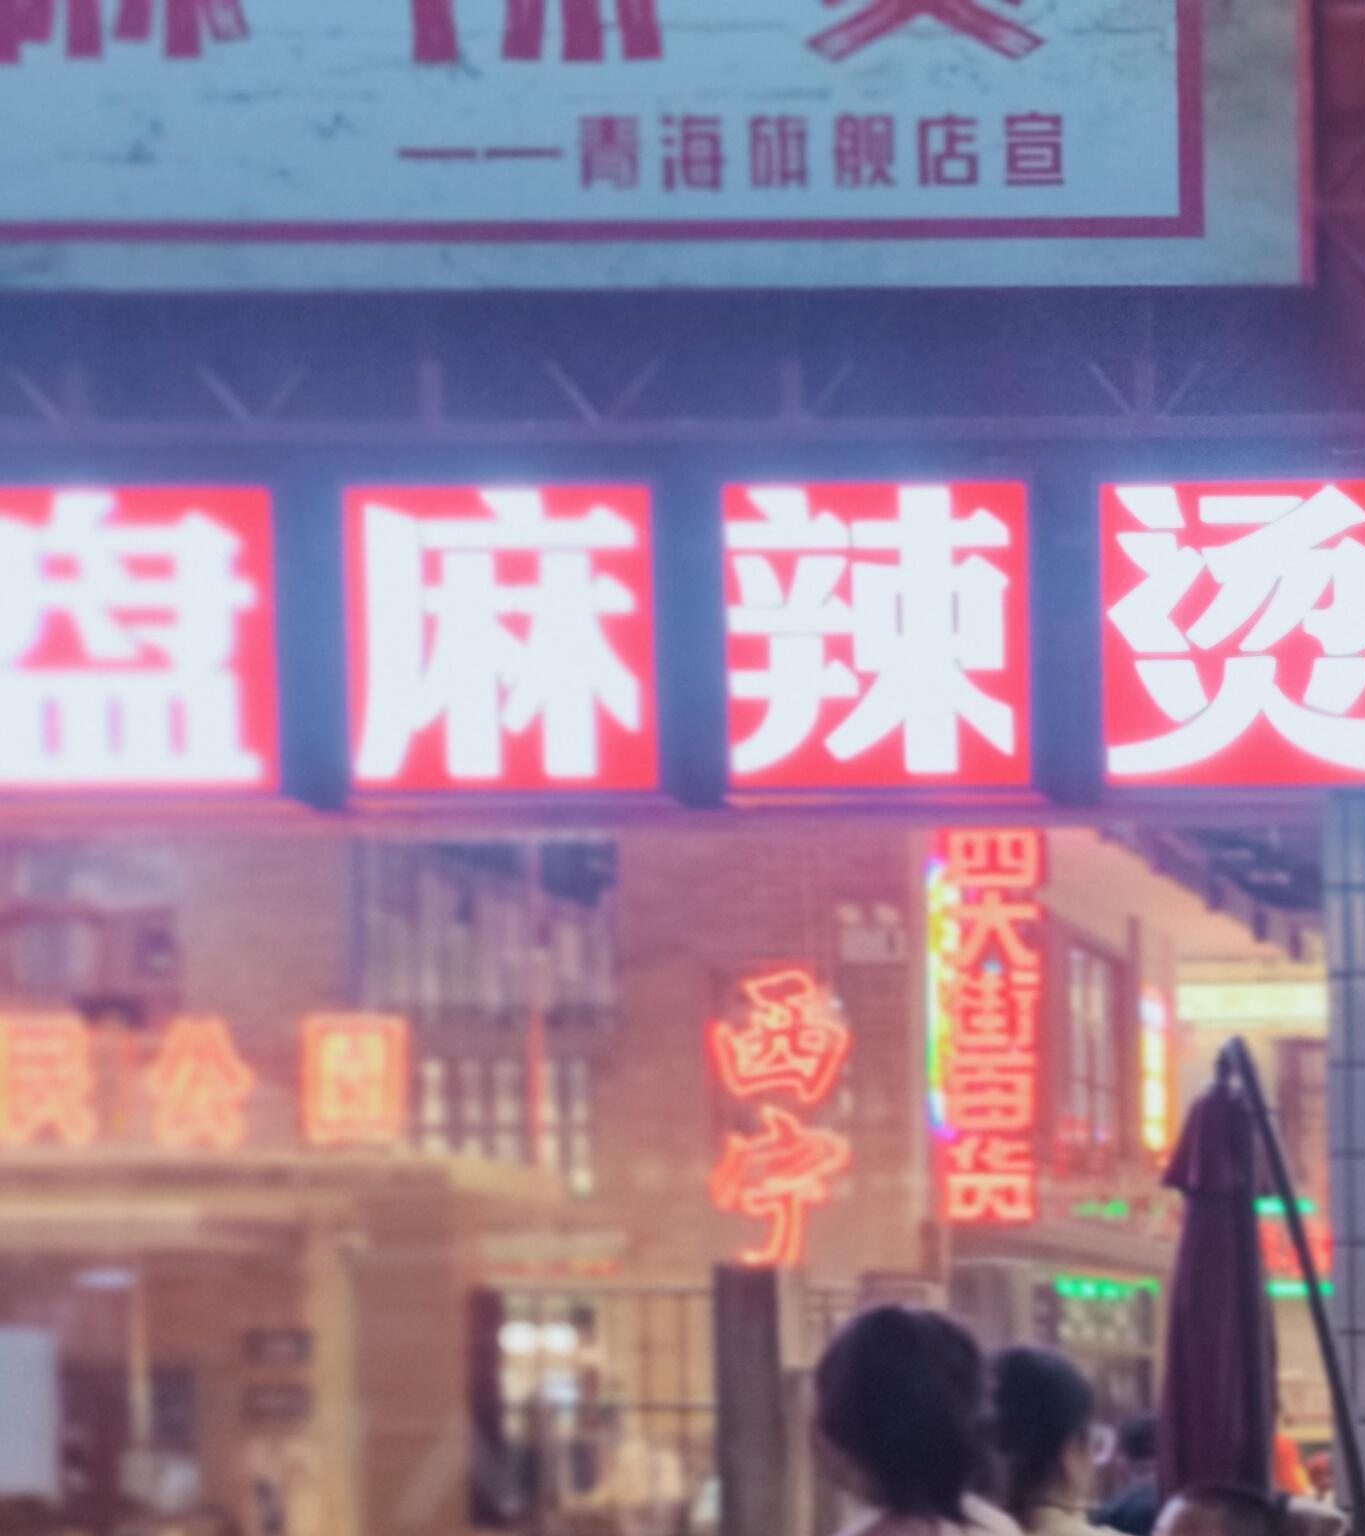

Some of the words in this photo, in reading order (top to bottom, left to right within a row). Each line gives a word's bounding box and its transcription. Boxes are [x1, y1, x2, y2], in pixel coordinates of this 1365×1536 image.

[945, 829, 1040, 1221] 四大街百货
